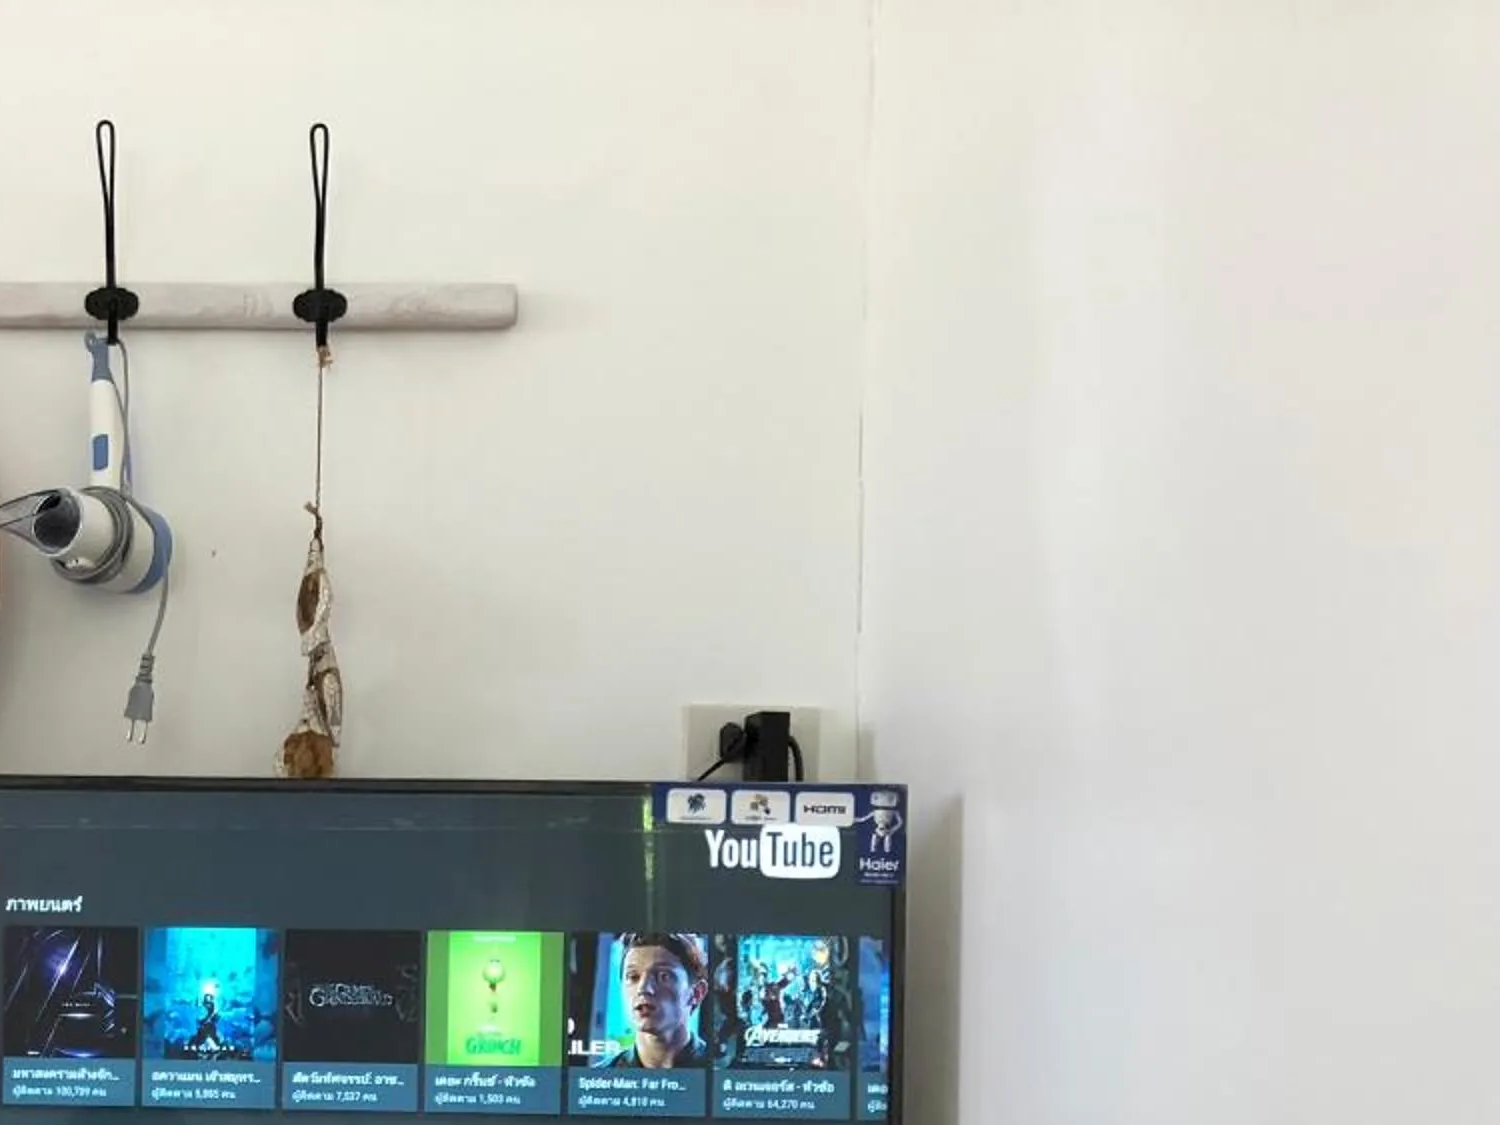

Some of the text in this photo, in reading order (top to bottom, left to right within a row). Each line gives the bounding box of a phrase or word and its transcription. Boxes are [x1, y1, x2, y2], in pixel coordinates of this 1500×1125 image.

[703, 829, 835, 869] YouTube
[859, 857, 900, 872] Haier
[4, 893, 84, 914] ภาพยนตร์
